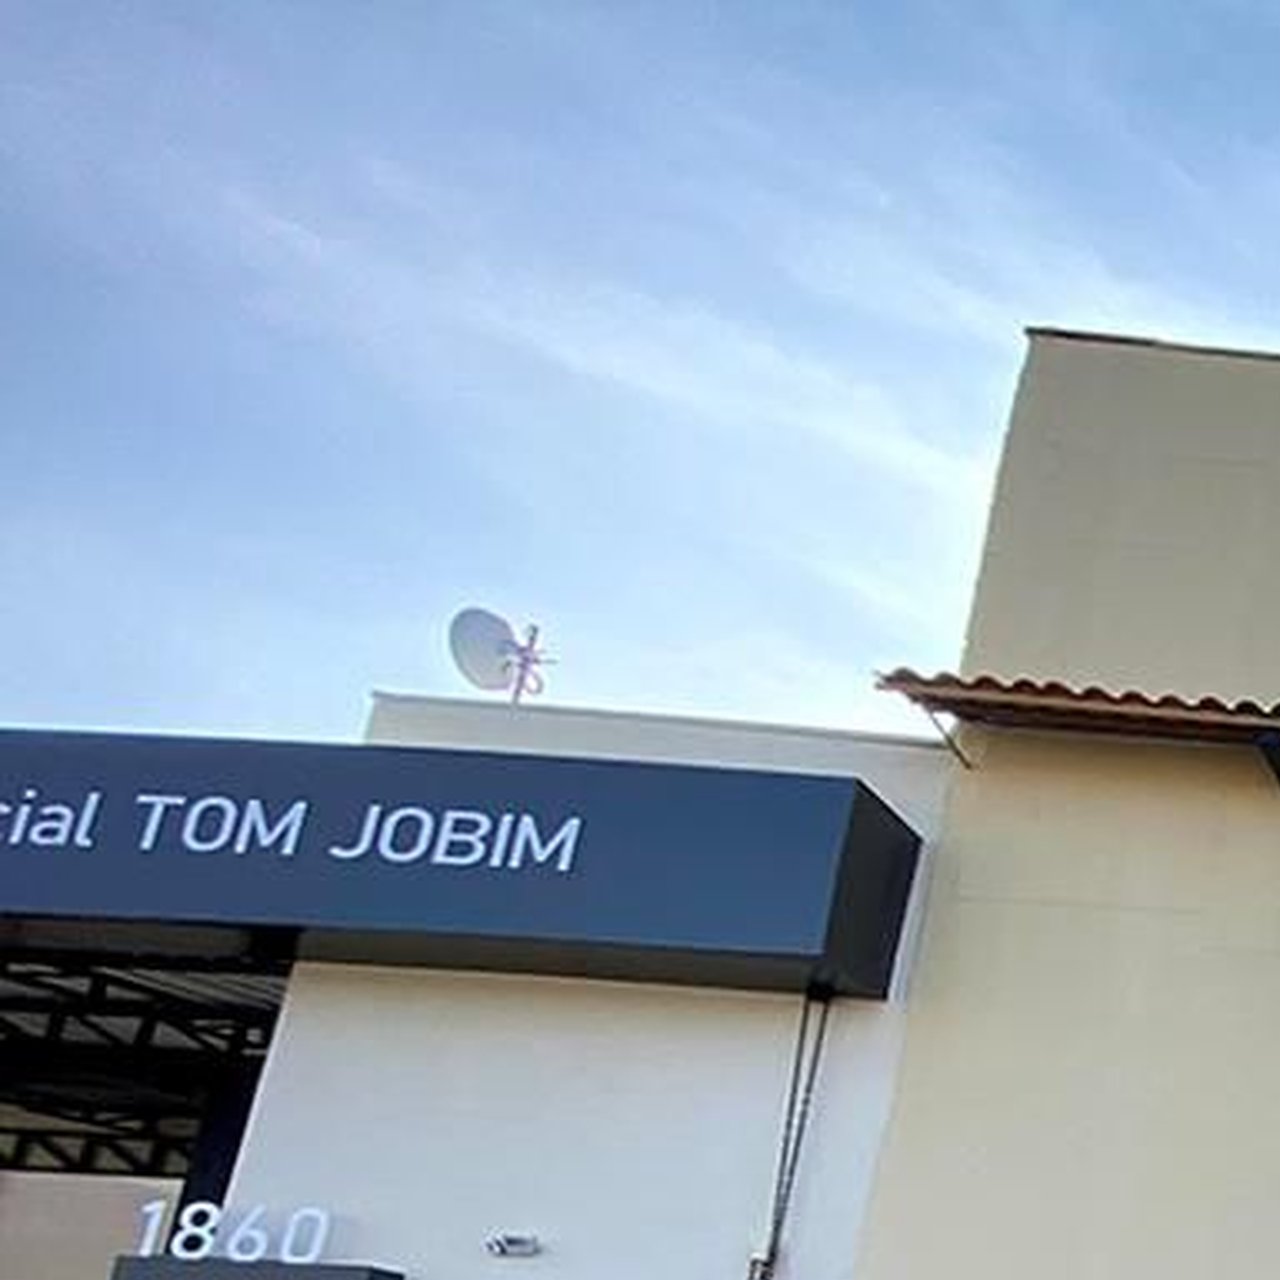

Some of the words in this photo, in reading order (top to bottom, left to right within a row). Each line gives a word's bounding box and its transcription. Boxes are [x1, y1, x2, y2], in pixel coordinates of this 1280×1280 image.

[136, 794, 309, 856] TOM
[330, 805, 583, 874] JOBIM
[138, 1202, 330, 1262] 1860
